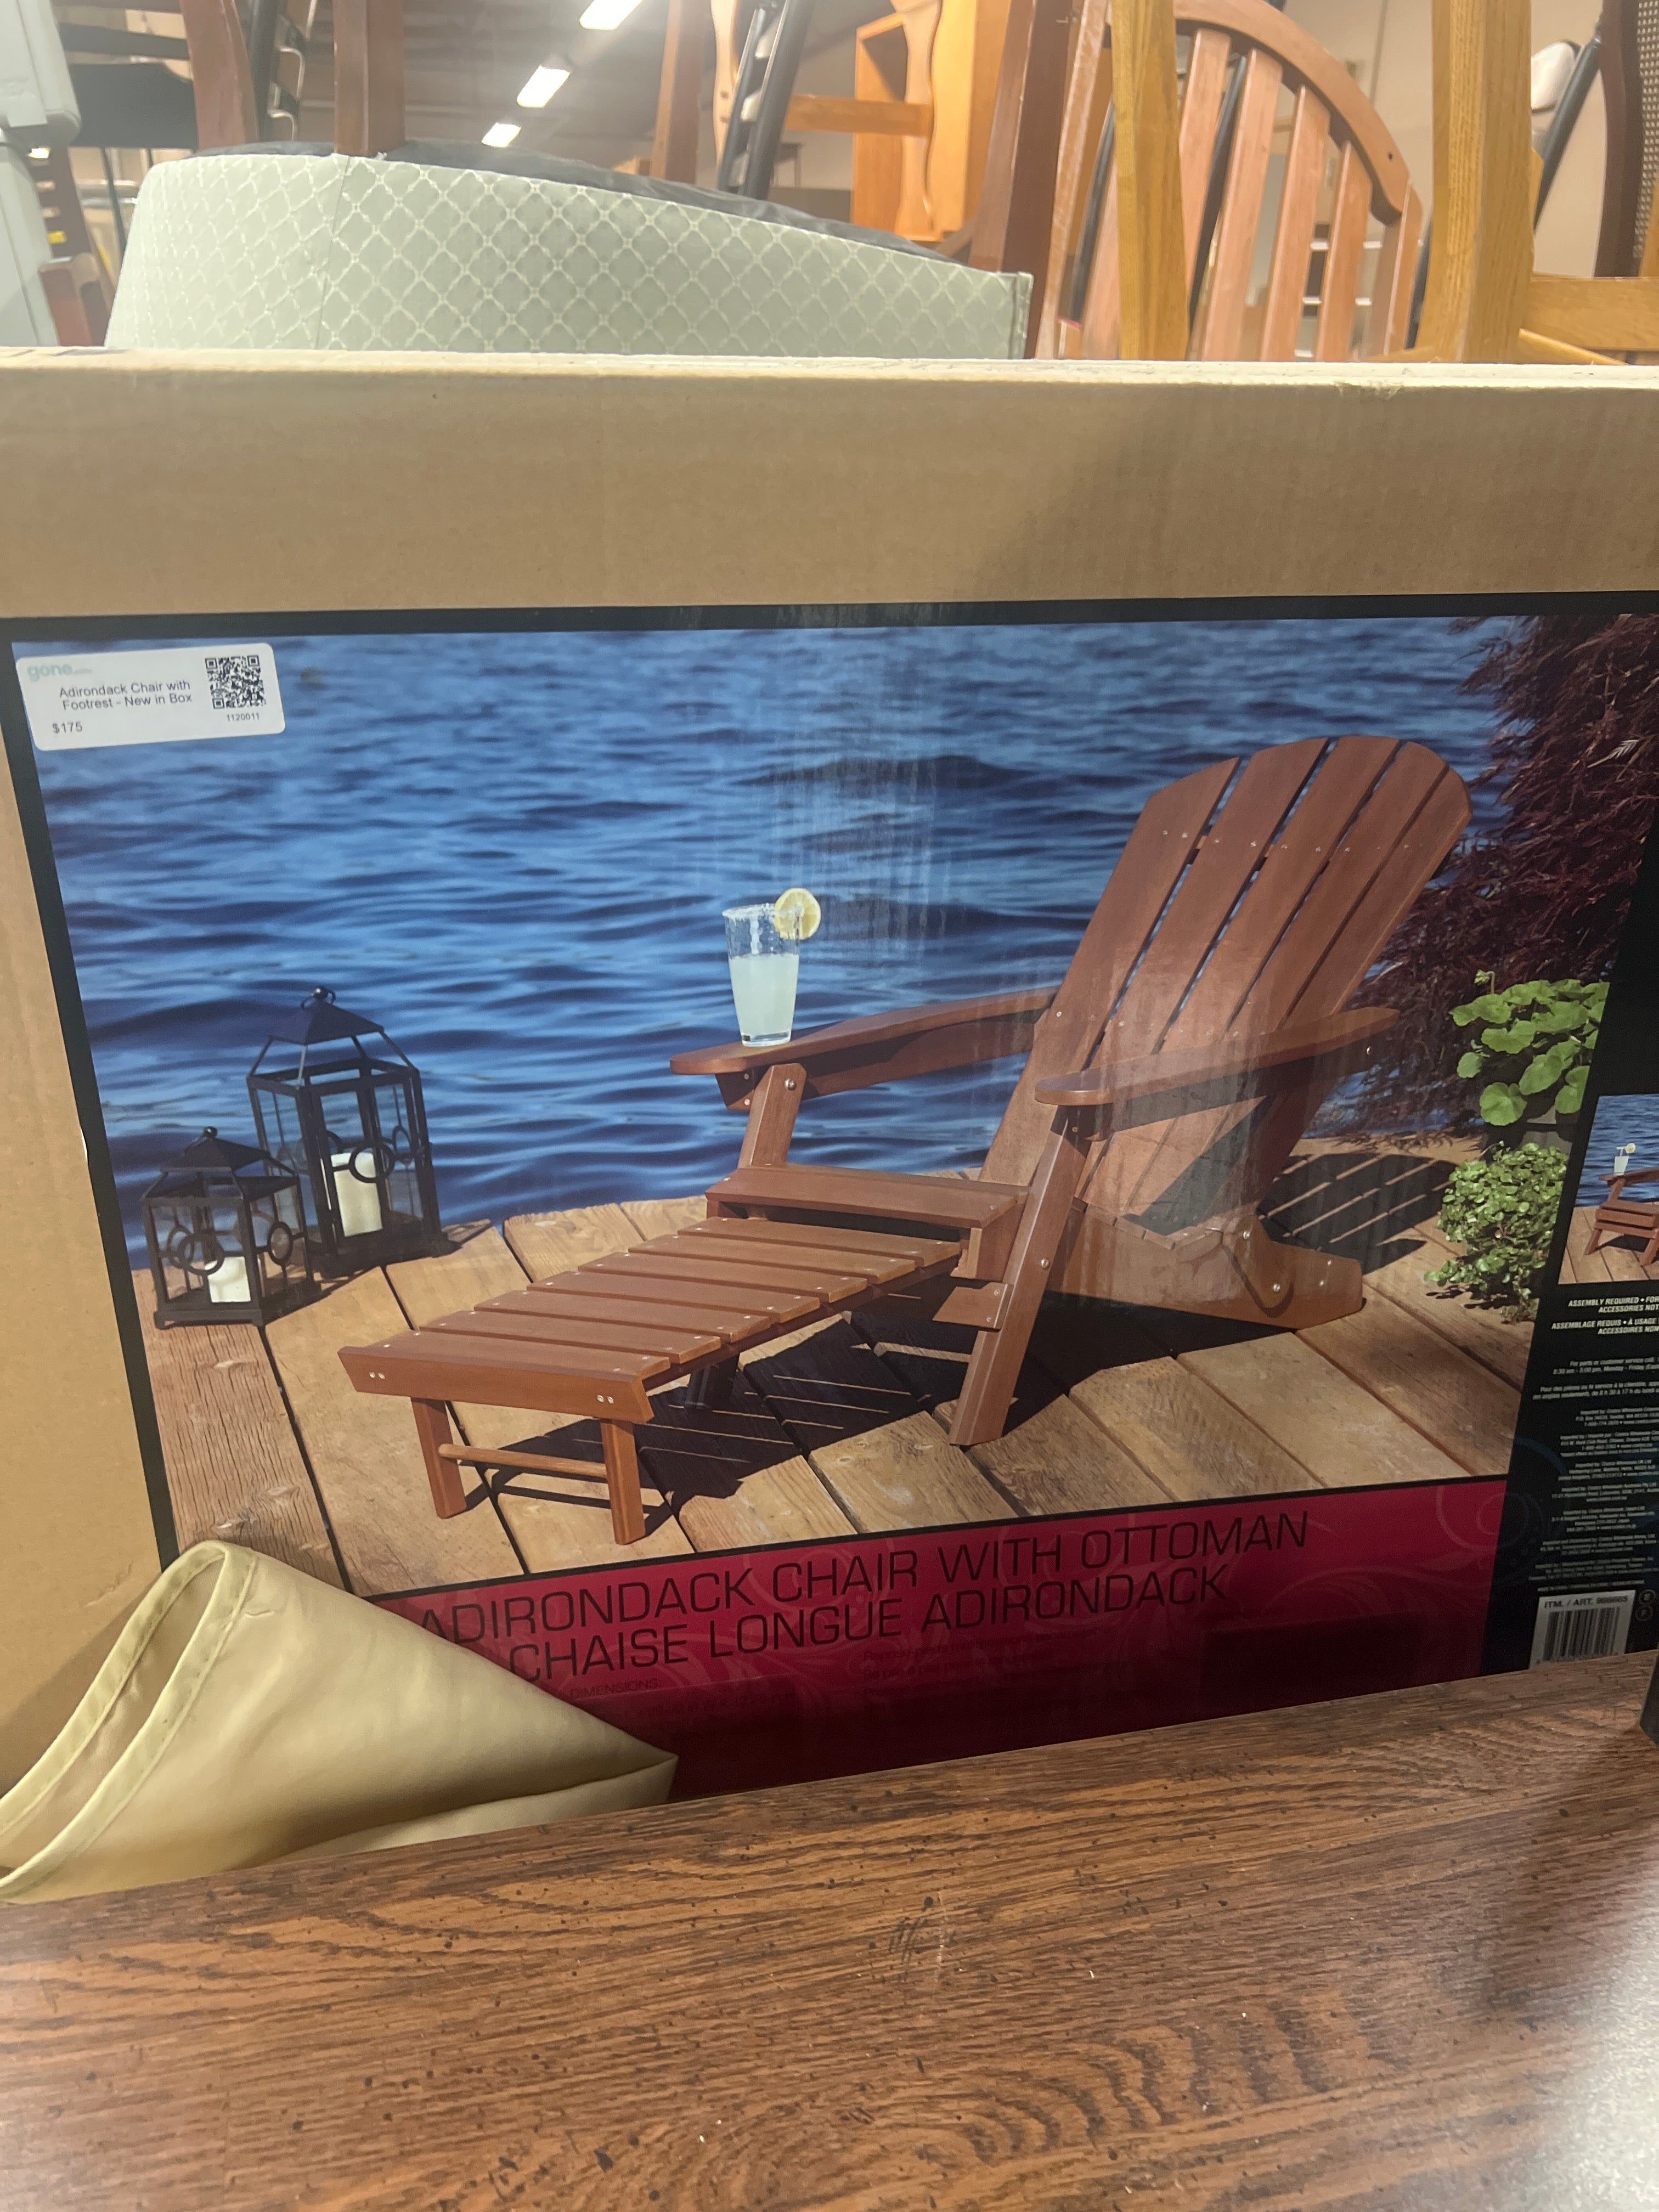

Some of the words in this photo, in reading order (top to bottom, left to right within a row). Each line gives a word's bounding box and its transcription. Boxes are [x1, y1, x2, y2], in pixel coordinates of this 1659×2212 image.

[59, 683, 127, 699] Adirondack
[131, 681, 163, 695] Chair
[166, 680, 191, 692] with
[63, 698, 114, 711] Footrest
[124, 695, 151, 707] New
[155, 693, 166, 705] in
[169, 692, 193, 704] Box
[225, 713, 260, 723] 1120011
[52, 721, 83, 735] $175
[1568, 1298, 1605, 1307] ASSEMBLY
[1605, 1296, 1639, 1305] REQUIRED
[1598, 1304, 1644, 1313] ACCESSORIES
[1551, 1320, 1596, 1330] ASSEMBLAGE
[1596, 1319, 1622, 1327] REQUIS
[421, 1568, 754, 1645] ADIRONDACK
[772, 1549, 918, 1603] CHAIR
[938, 1534, 1062, 1583] WITH
[1080, 1511, 1308, 1570] OTTOMAN
[509, 1623, 689, 1683] CHAISE
[710, 1599, 902, 1658] LONGUE
[921, 1565, 1226, 1634] ADIRONDACK
